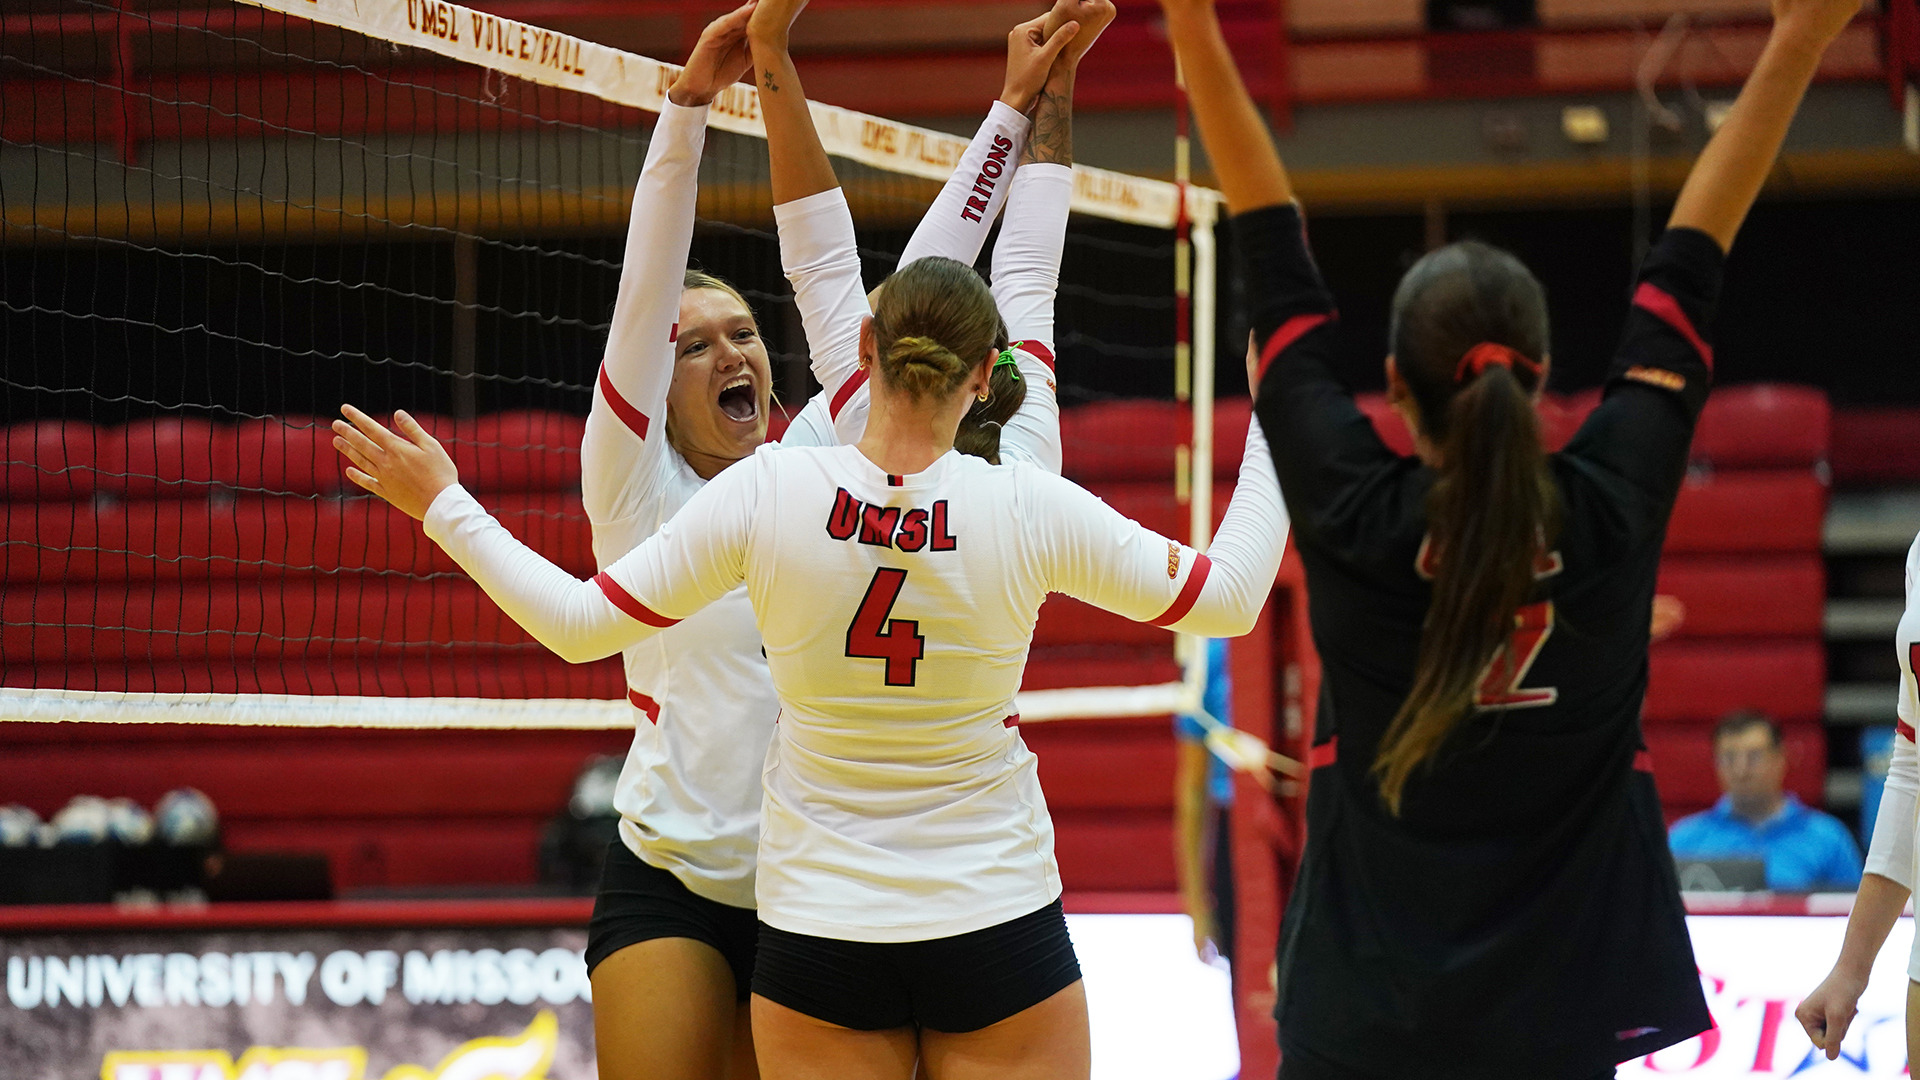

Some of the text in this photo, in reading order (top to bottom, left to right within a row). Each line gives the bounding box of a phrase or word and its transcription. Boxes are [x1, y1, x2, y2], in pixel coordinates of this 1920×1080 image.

[407, 0, 585, 77] UMSL VOLLEYBALL
[960, 133, 1013, 224] TRITONS
[826, 486, 957, 553] UMSL
[845, 566, 925, 687] 4
[7, 951, 317, 1009] UNIVERSITY
[320, 949, 399, 1007] OF
